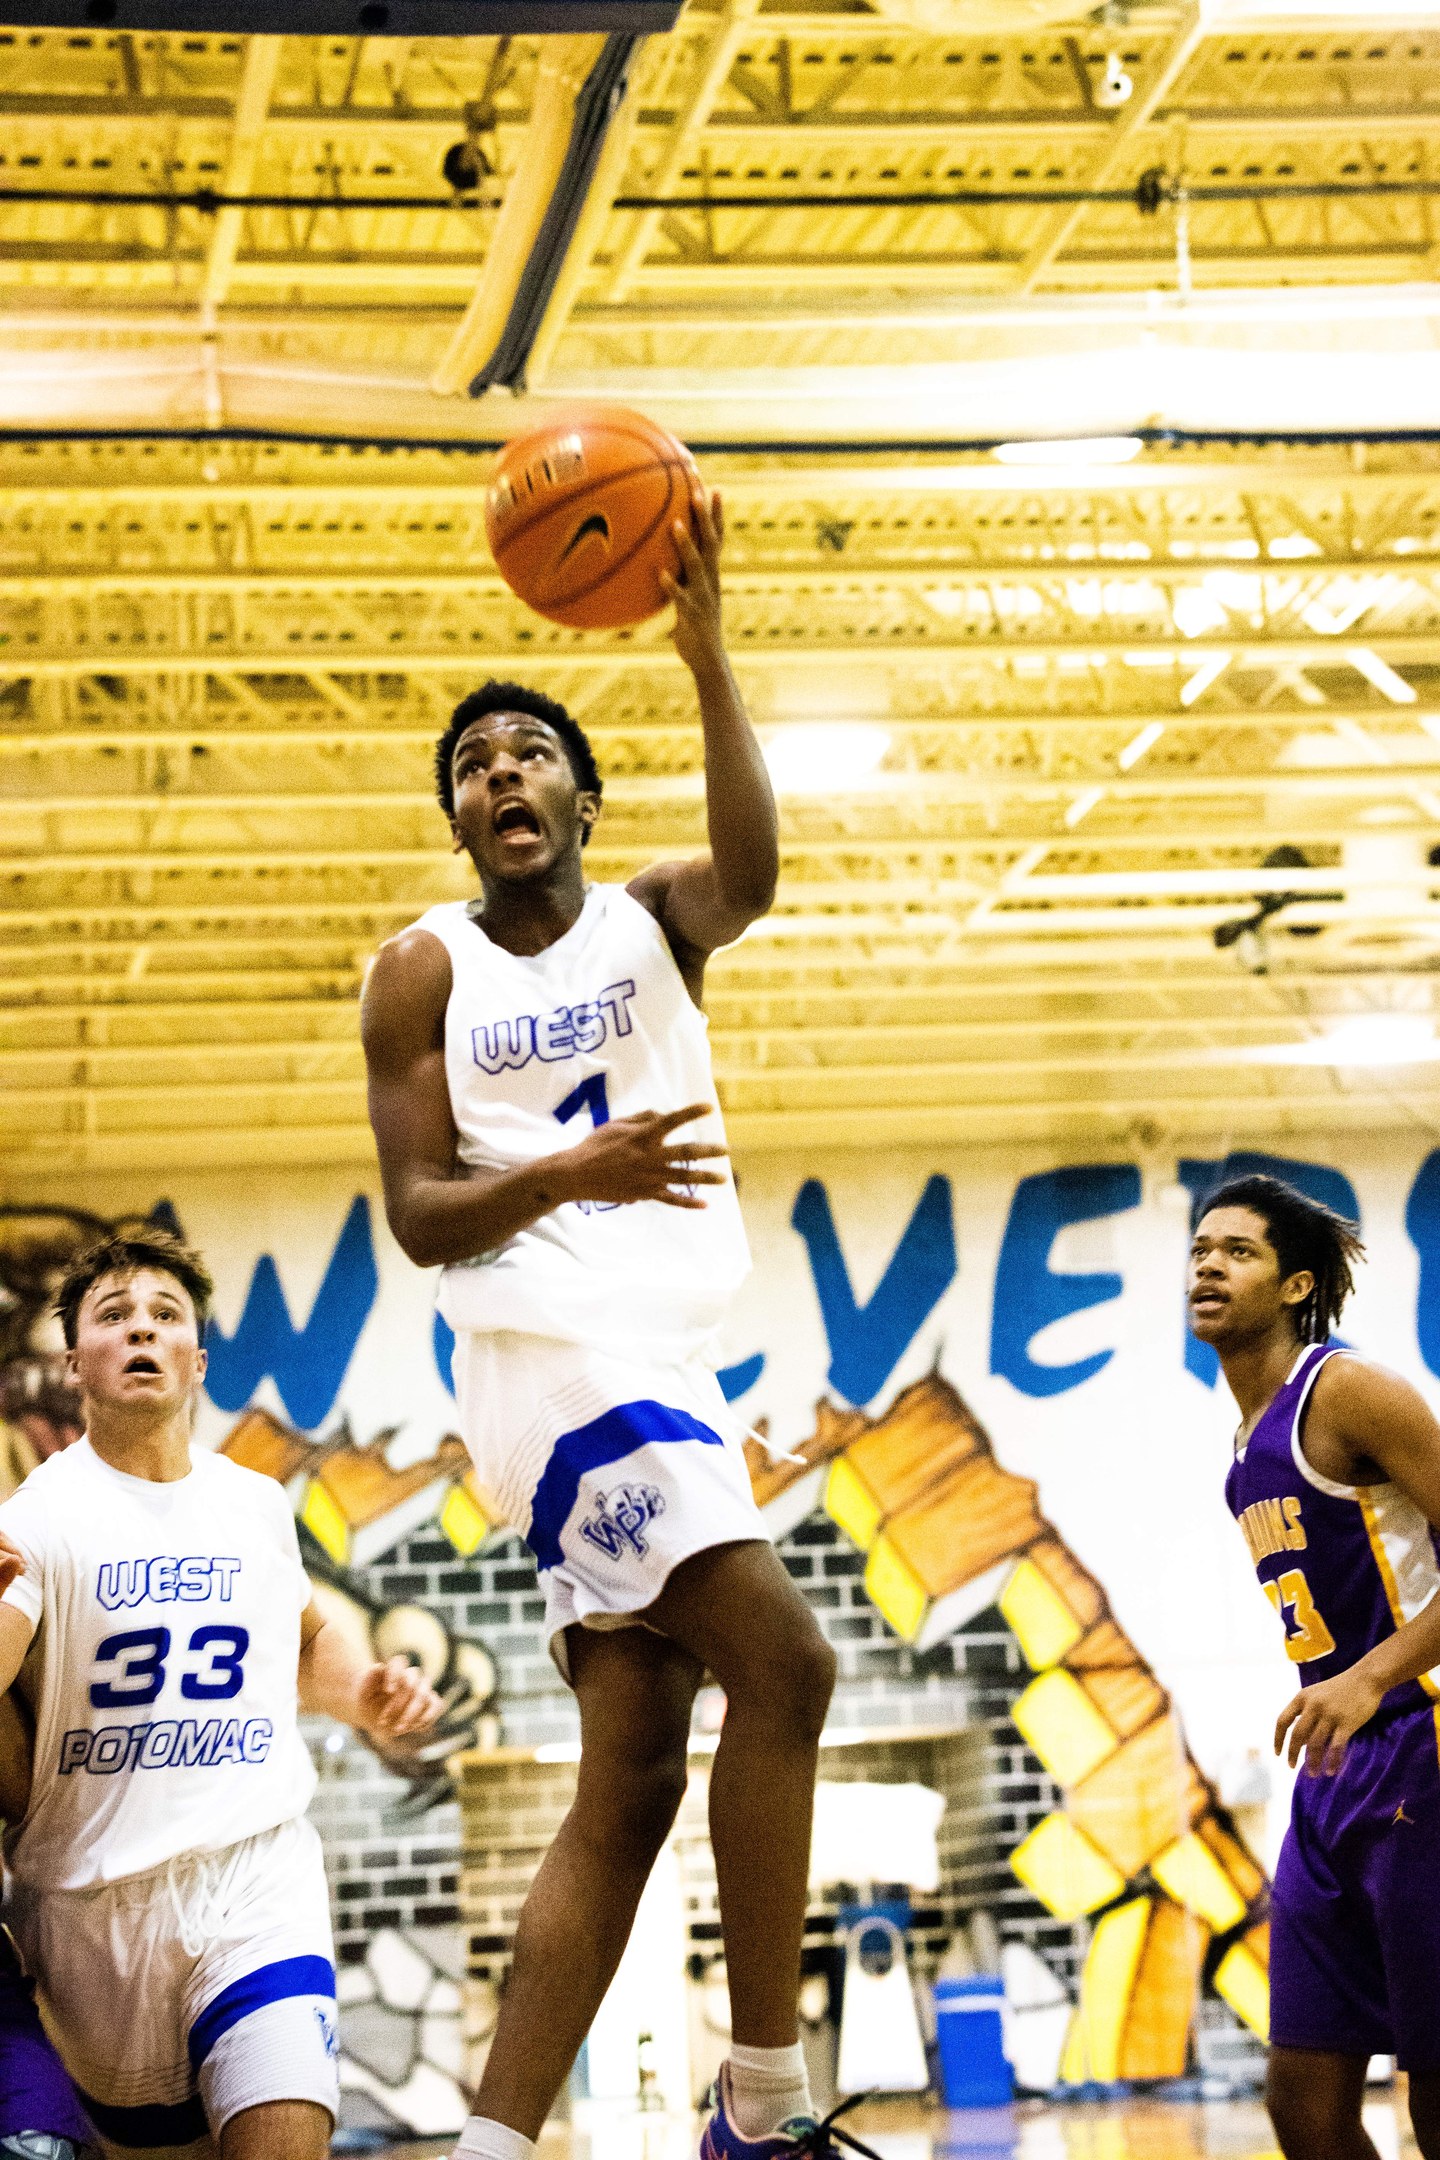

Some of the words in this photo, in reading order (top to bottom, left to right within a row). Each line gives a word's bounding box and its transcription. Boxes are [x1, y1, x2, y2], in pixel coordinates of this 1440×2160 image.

[472, 979, 636, 1075] WEST
[553, 1072, 610, 1128] 1
[96, 1556, 241, 1611] WEST
[89, 1624, 250, 1709] 33
